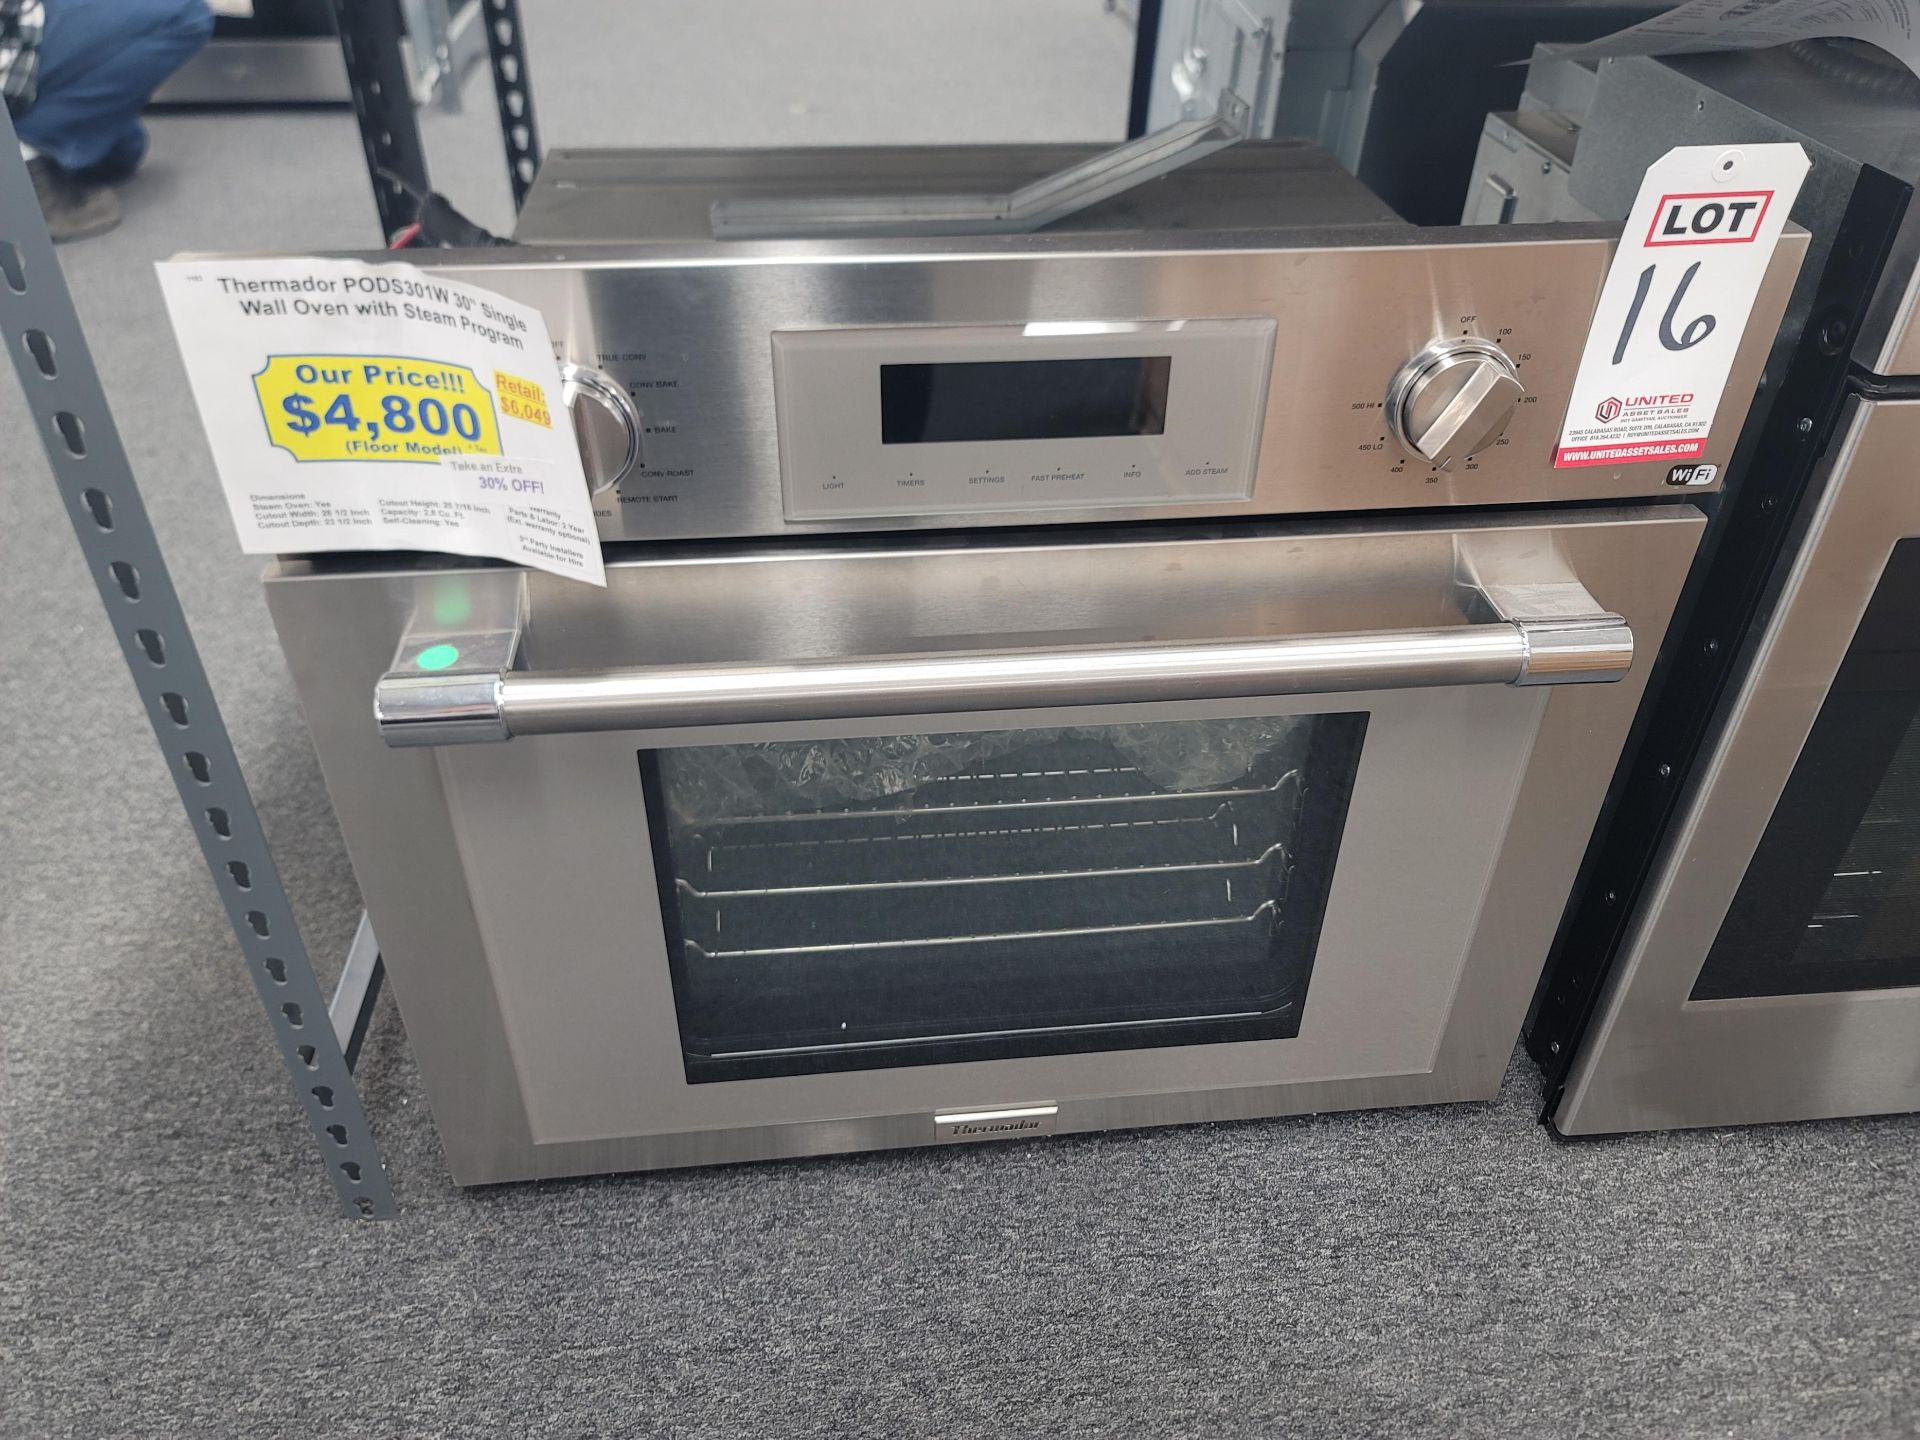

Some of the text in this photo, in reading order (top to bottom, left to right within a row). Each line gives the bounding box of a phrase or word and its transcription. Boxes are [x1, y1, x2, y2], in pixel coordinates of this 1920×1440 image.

[1662, 202, 1757, 235] LOT
[217, 276, 337, 294] Thermador
[344, 277, 449, 303] PODS301W
[481, 302, 527, 332] Single
[1612, 261, 1717, 365] 16
[240, 299, 524, 351] Wall Oven with Steam Program
[1460, 315, 1477, 323] OFF
[1518, 353, 1531, 361] 150
[296, 364, 465, 393] Our Price!!!
[496, 374, 546, 403] Retail:
[1626, 394, 1694, 406] UNITED
[282, 392, 481, 441] $4,800
[501, 396, 552, 425] $6,049
[346, 440, 400, 454] (Floor
[1563, 443, 1698, 462] WWW.UNITEDASSETSALES.COM
[451, 461, 523, 474] Take an Extra
[641, 470, 665, 478] CONV
[479, 476, 545, 494] 30% OFF!
[823, 482, 844, 490] LIGHT
[968, 476, 1005, 484] SETTINGS
[1051, 473, 1084, 481] PREHEAT
